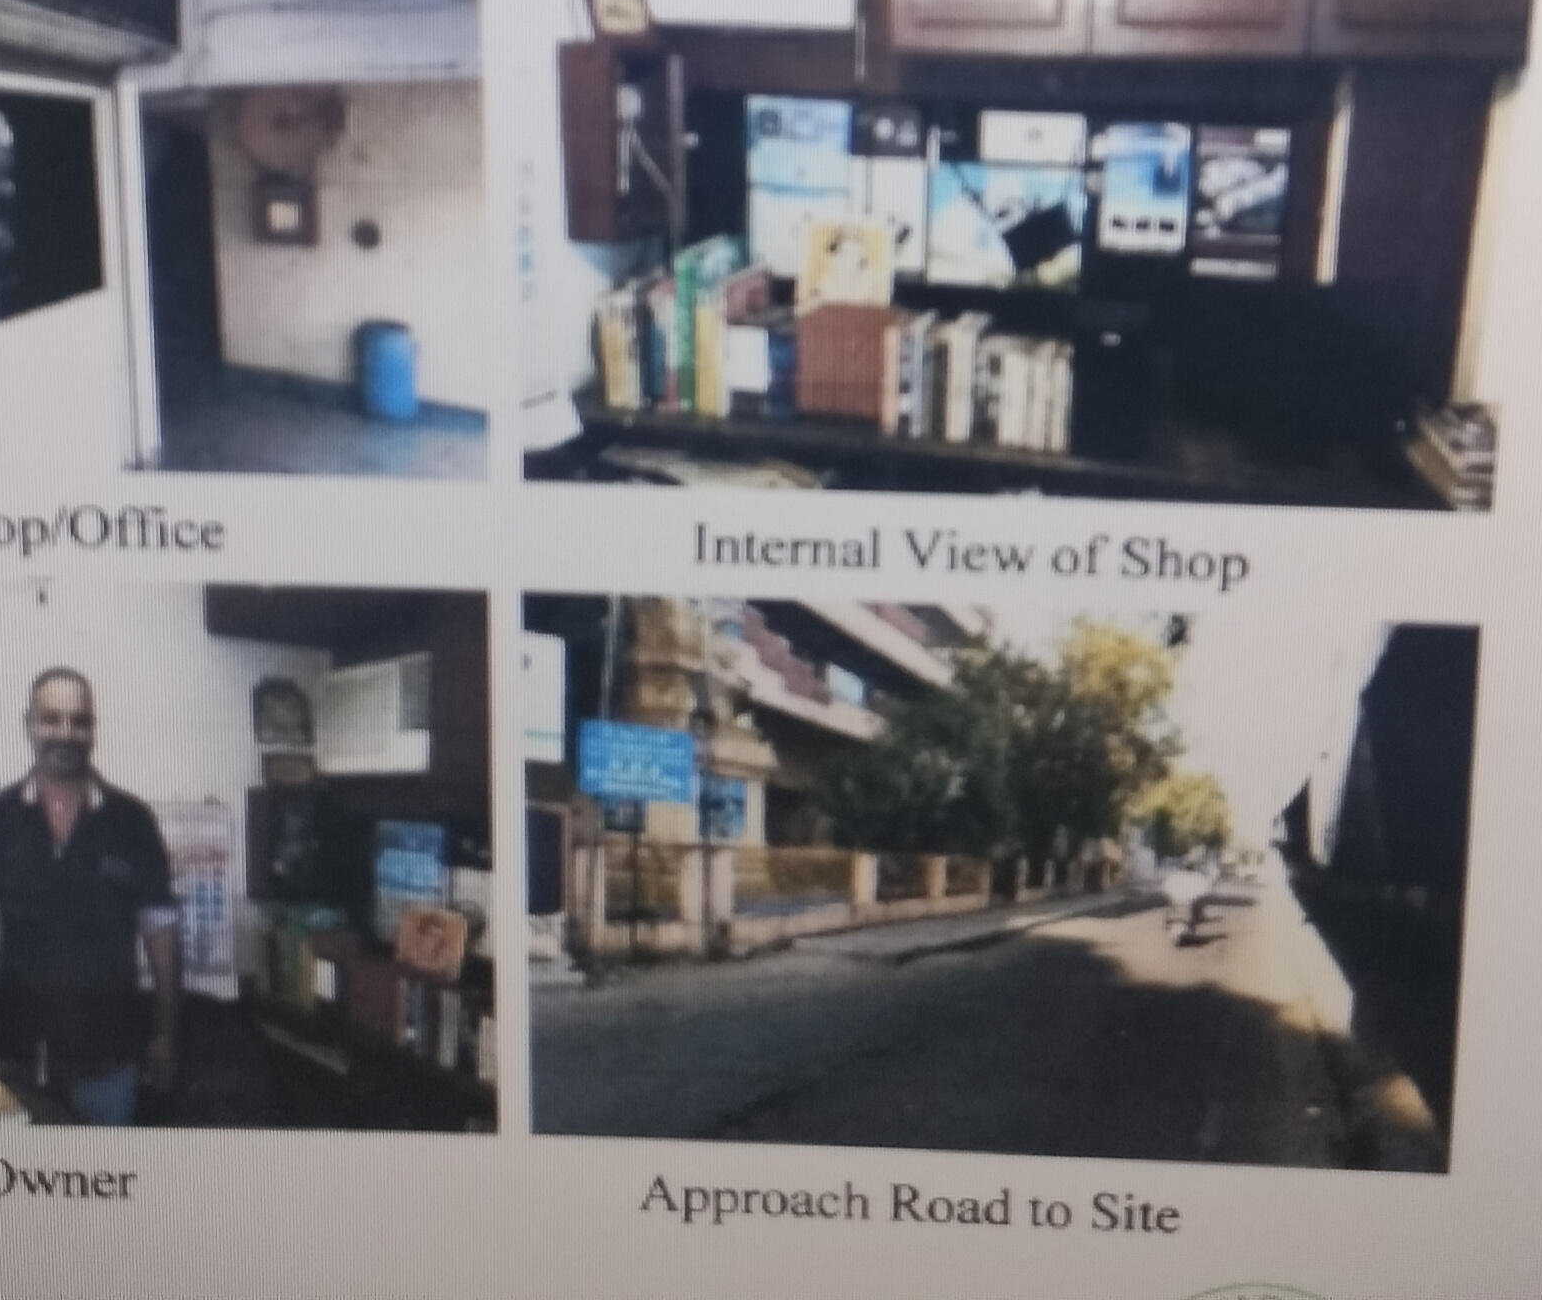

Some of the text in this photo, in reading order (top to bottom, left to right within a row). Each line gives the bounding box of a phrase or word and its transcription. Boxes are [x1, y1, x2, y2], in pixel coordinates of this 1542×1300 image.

[695, 522, 1250, 594] Internal View of Shop
[640, 1175, 1180, 1235] Approach Road to Site
